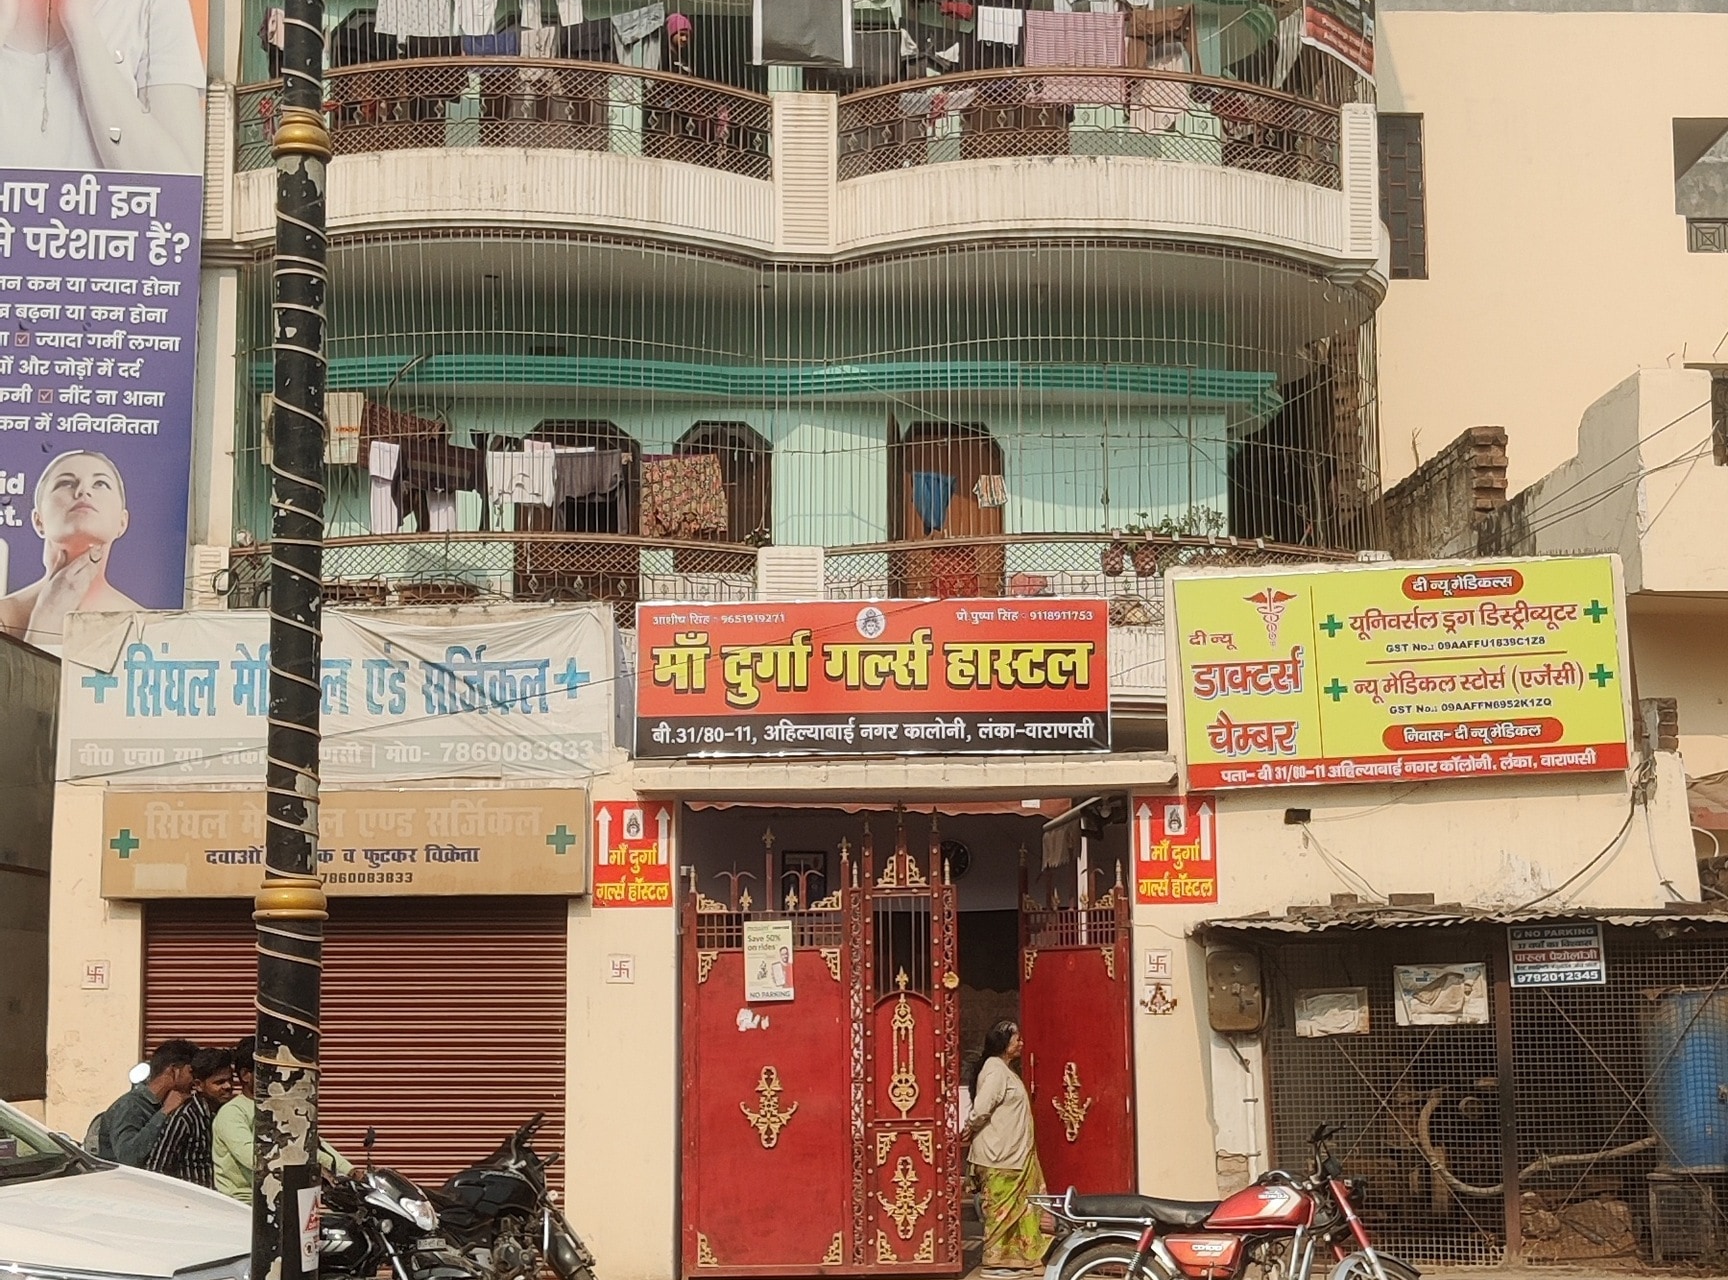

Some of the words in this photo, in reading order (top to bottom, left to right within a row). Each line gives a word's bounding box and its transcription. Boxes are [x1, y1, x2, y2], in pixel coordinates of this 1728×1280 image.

[59, 174, 101, 215] भी
[108, 185, 161, 219] इन
[23, 218, 139, 261] परेशान
[26, 276, 62, 293] कम
[65, 277, 87, 293] या
[90, 277, 138, 295] ज्यादा
[142, 275, 181, 297] होना
[15, 303, 61, 323] बढ़ना
[65, 304, 86, 320] या
[90, 305, 126, 322] कम
[129, 303, 168, 324] होना
[35, 332, 83, 349] ज्यादा
[87, 329, 127, 350] गर्मी
[128, 335, 182, 352] लगना
[18, 355, 51, 377] और
[54, 356, 95, 381] जोड़ों
[97, 357, 115, 378] में
[117, 358, 144, 379] दर्द
[58, 384, 92, 405] नींद
[95, 389, 118, 406] ना
[122, 390, 166, 407] आना
[34, 412, 53, 432] में
[56, 413, 160, 436] अनियमितता
[1412, 577, 1428, 593] दी
[1430, 579, 1453, 596] न्यू
[1452, 575, 1513, 591] मेडिकल्स
[721, 611, 785, 625] 9651919271
[1029, 610, 1093, 622] 9118911753
[1348, 605, 1439, 641] यूनिवर्सल
[1479, 600, 1578, 631] डिस्ट्रीब्यूटर
[1189, 630, 1206, 645] दी
[1209, 633, 1237, 650] न्यू
[1386, 643, 1408, 653] GST
[651, 631, 711, 693] माँ
[722, 627, 814, 706] दुर्गा
[822, 626, 935, 691] गर्ल्स
[944, 640, 1096, 689] हास्टल
[1191, 646, 1304, 700] डाक्टर्स
[123, 642, 220, 717] सिंघल
[361, 642, 410, 716] एंड
[418, 643, 550, 716] सर्जिकल
[1353, 677, 1384, 704] न्यू
[1382, 670, 1457, 695] मेडिकल
[1459, 665, 1506, 691] स्टोर्स
[1389, 705, 1412, 714] GST
[764, 716, 856, 744] अहिल्याबाई
[859, 722, 899, 741] नगर
[1207, 710, 1299, 757] चैम्बर
[1454, 725, 1469, 740] दी
[1470, 728, 1492, 744] न्यू
[1490, 723, 1542, 739] मेडिकल
[439, 739, 594, 763] 7860083833
[1404, 761, 1438, 774] नगर
[1540, 747, 1597, 767] वाराणसी
[425, 798, 544, 839] सर्जिकल
[204, 845, 264, 866] दवाओं
[342, 848, 357, 864] व
[362, 847, 418, 869] फुटकर
[424, 843, 481, 864] विक्रेता
[629, 842, 657, 874] दुर्गा
[1171, 837, 1200, 870] दुर्गा
[320, 871, 414, 885] 7860083833
[747, 934, 764, 942] Save
[1524, 930, 1540, 938] NO
[1544, 927, 1594, 937] PARKING
